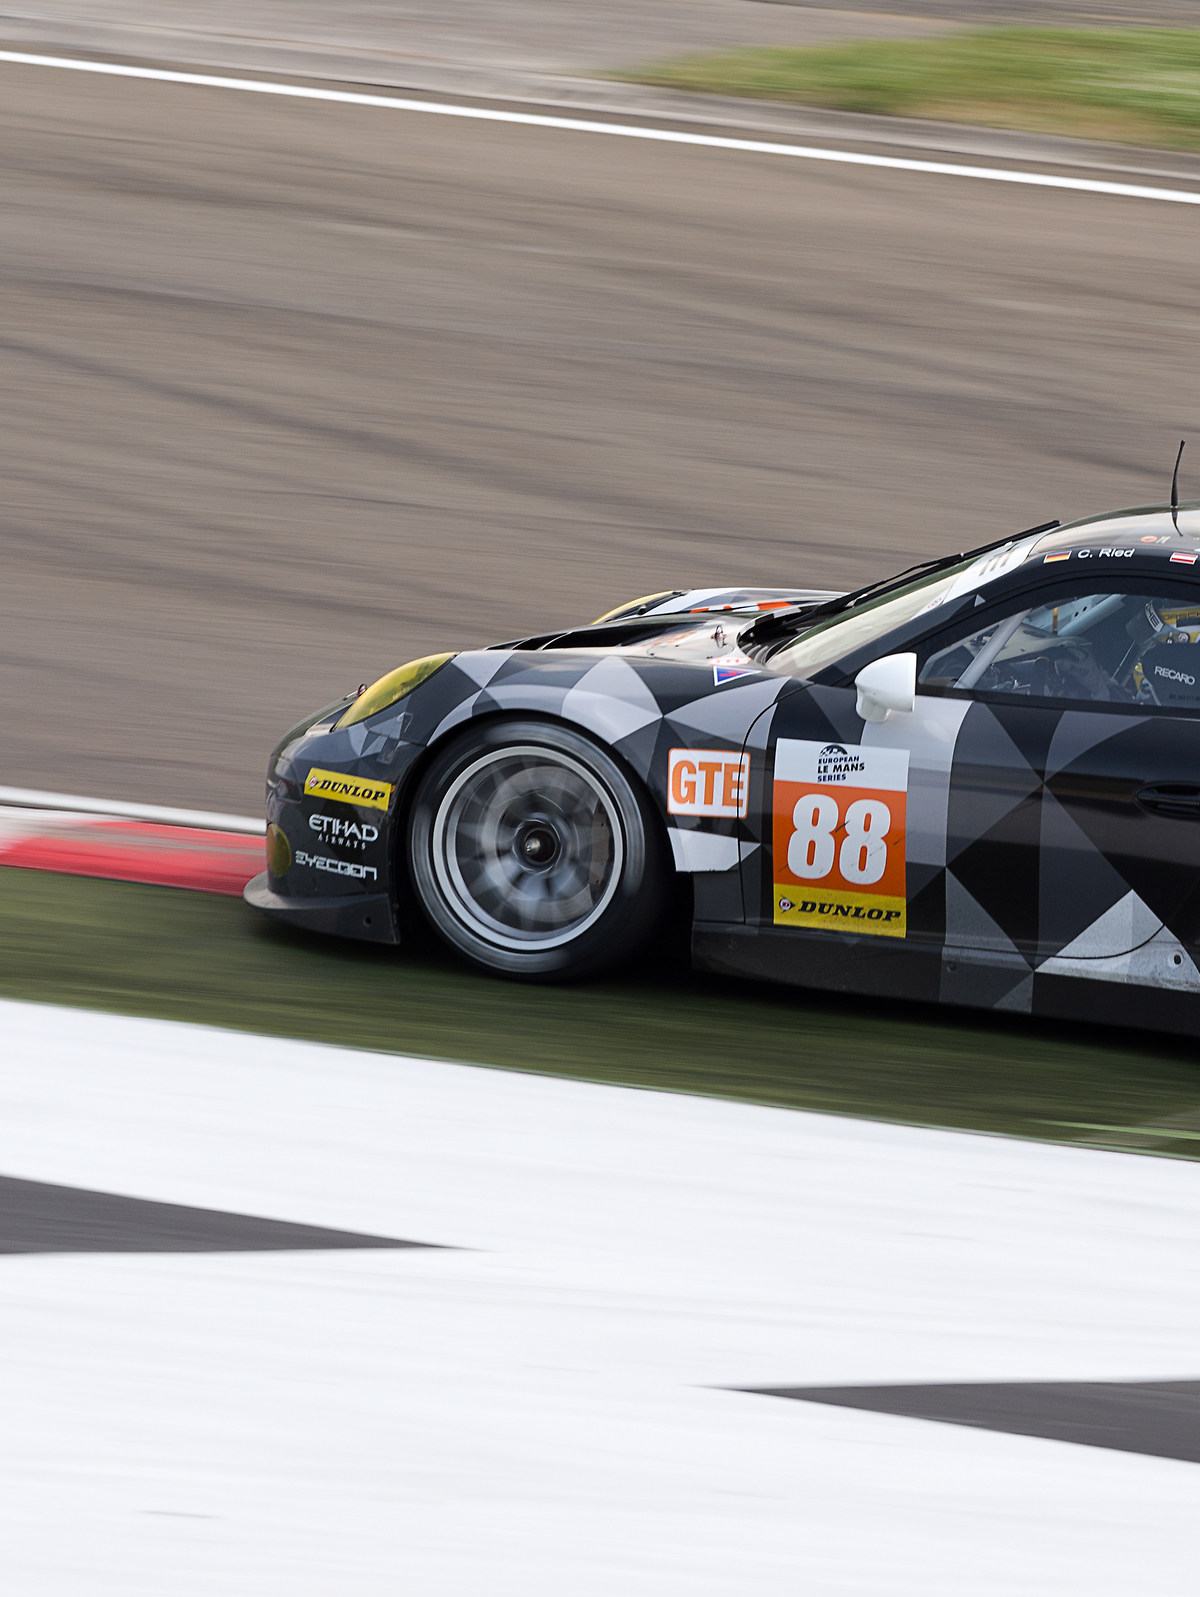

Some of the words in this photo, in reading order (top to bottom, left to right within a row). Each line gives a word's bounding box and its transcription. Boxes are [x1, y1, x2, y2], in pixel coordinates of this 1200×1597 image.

[1077, 549, 1093, 559] C.
[1098, 548, 1136, 558] Ried
[1154, 665, 1196, 686] RECARO
[817, 765, 829, 774] LE
[832, 762, 865, 773] MANS
[818, 755, 860, 765] EUROPEAN
[671, 760, 746, 808] GTE
[817, 773, 847, 783] SERIES
[319, 779, 386, 802] DUNLOP
[308, 813, 379, 842] ETIHAD
[317, 833, 366, 851] AIRWAYS
[787, 793, 891, 885] 88
[798, 900, 902, 923] DUNLOP
